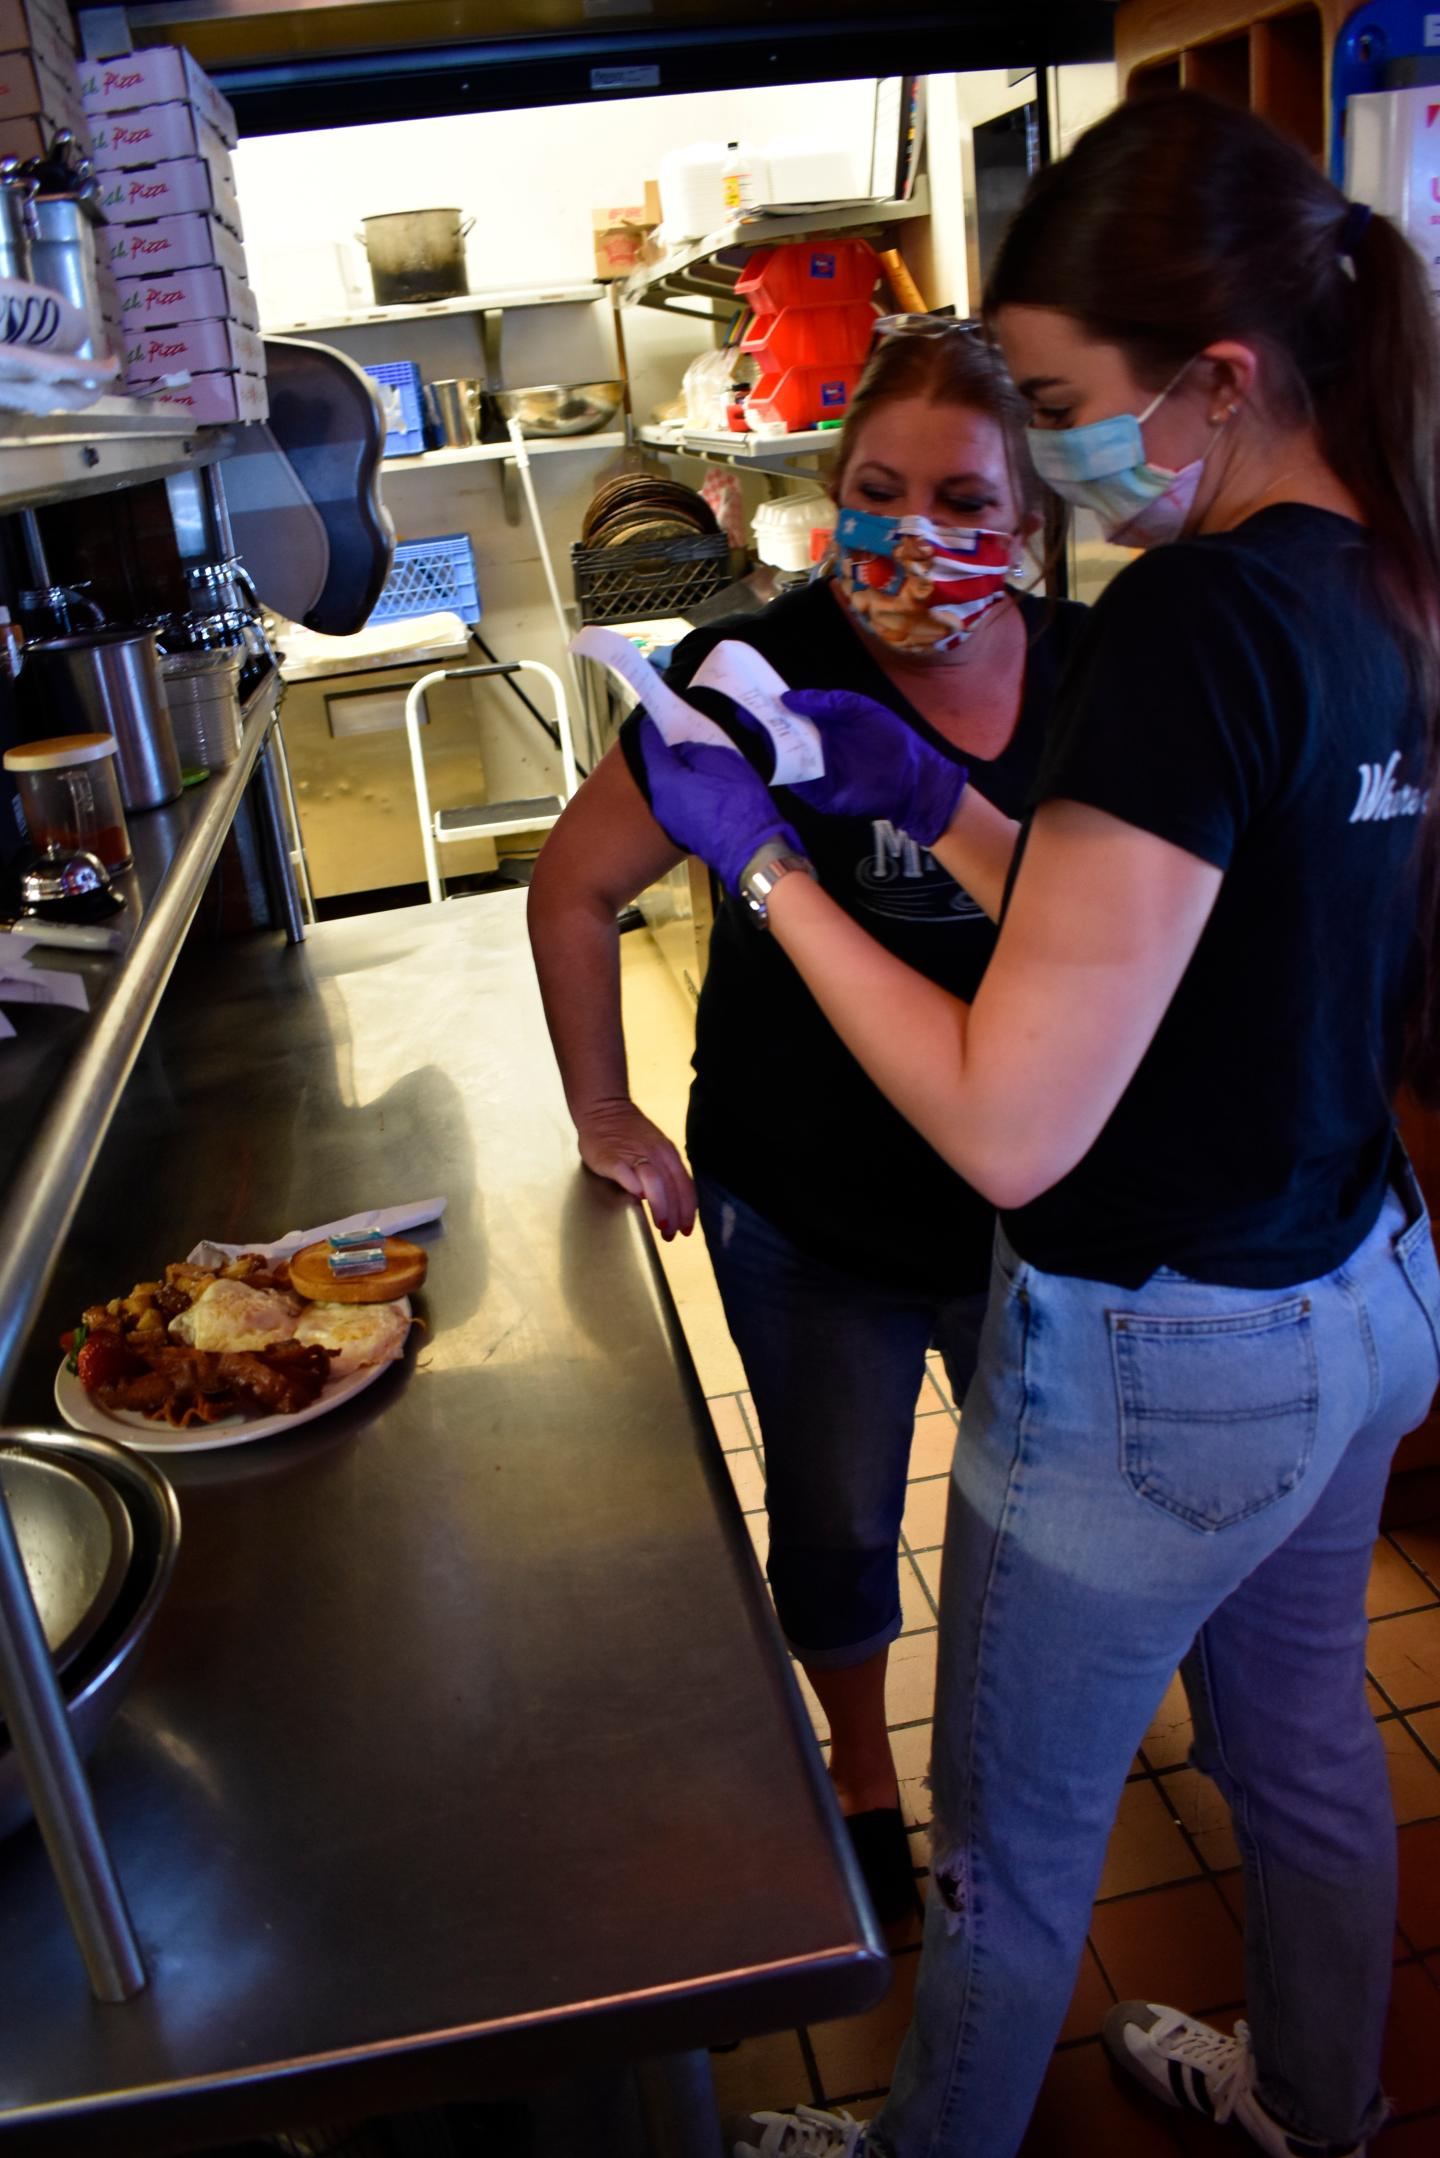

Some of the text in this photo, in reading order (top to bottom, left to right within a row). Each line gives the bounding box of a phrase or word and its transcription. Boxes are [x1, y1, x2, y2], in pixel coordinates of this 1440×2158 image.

[104, 72, 144, 96] Pizza
[112, 127, 153, 150] Pizza
[128, 181, 169, 205] Pizza
[131, 236, 171, 260] Pizza
[145, 288, 185, 310] Pizza
[148, 341, 188, 362] Pizza
